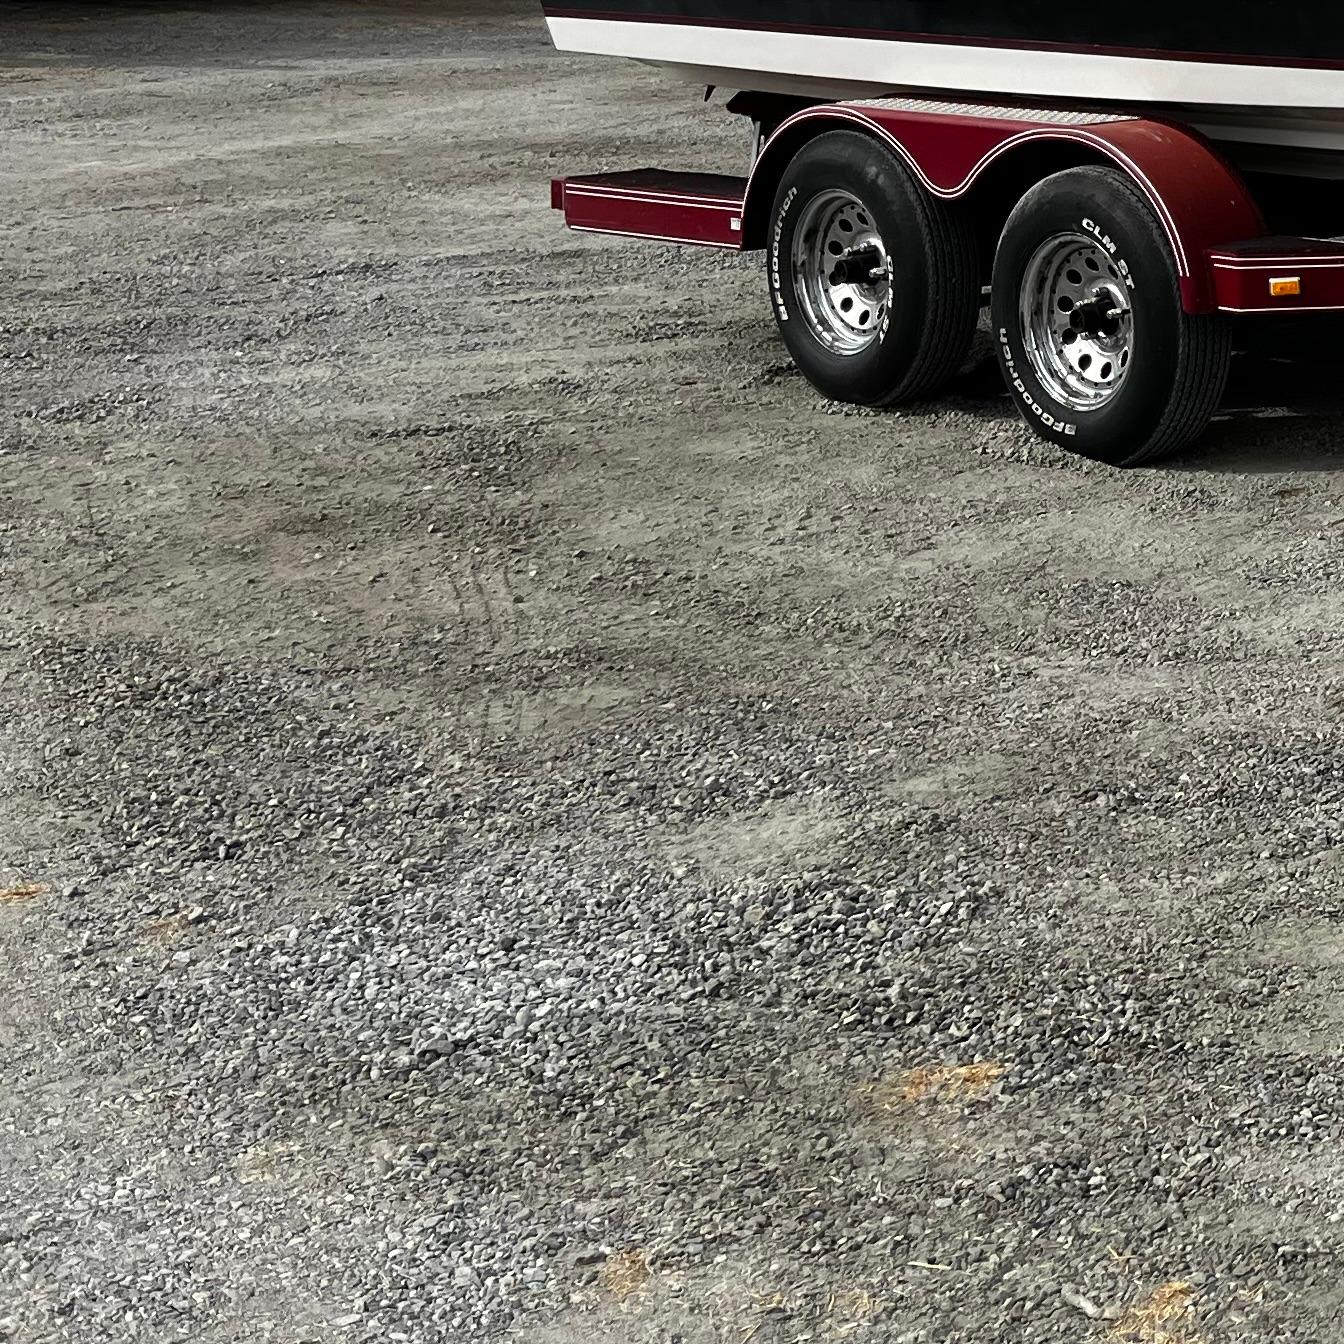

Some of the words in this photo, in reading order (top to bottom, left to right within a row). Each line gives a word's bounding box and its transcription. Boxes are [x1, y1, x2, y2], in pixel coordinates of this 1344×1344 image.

[772, 186, 798, 321] BFGoodrich
[1081, 217, 1117, 255] CLM
[1117, 259, 1135, 289] ST
[1000, 327, 1077, 436] BFGoodrich
